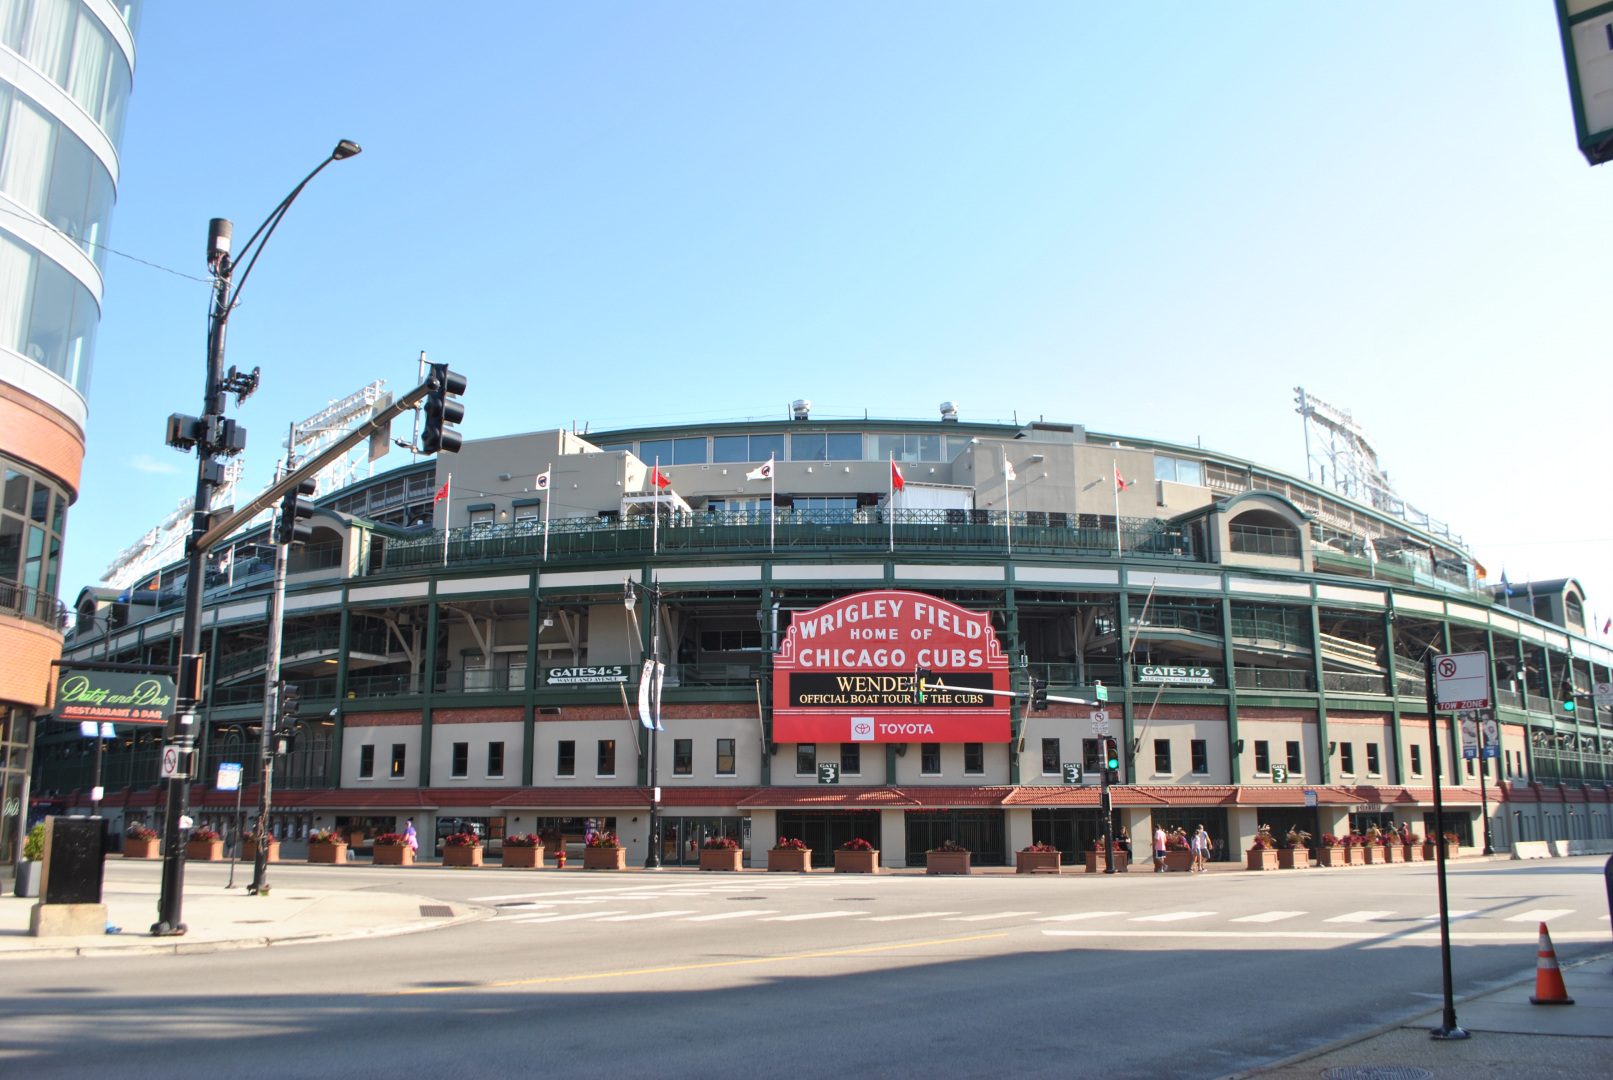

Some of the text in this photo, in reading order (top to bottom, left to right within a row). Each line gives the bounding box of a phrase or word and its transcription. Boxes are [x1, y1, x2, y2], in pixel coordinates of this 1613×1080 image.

[800, 600, 982, 640] WRIGLEY FIELD
[850, 629, 933, 640] HOME OF
[800, 648, 983, 667] CHICAGO CUBS
[549, 667, 597, 677] GATES
[1142, 666, 1187, 677] GATES
[106, 690, 140, 704] and
[799, 694, 848, 704] OFFICIAL
[850, 694, 879, 704] BOAT
[881, 694, 912, 704] TOUR
[931, 694, 954, 704] THE
[954, 694, 984, 704] CUBS
[1440, 700, 1484, 710] TOW ZONE
[64, 705, 131, 717] RESTAURANT
[140, 709, 163, 719] BAR
[879, 723, 934, 735] TOYOTA
[821, 767, 835, 780] 3
[1066, 767, 1079, 780] 3
[1274, 768, 1285, 780] 3
